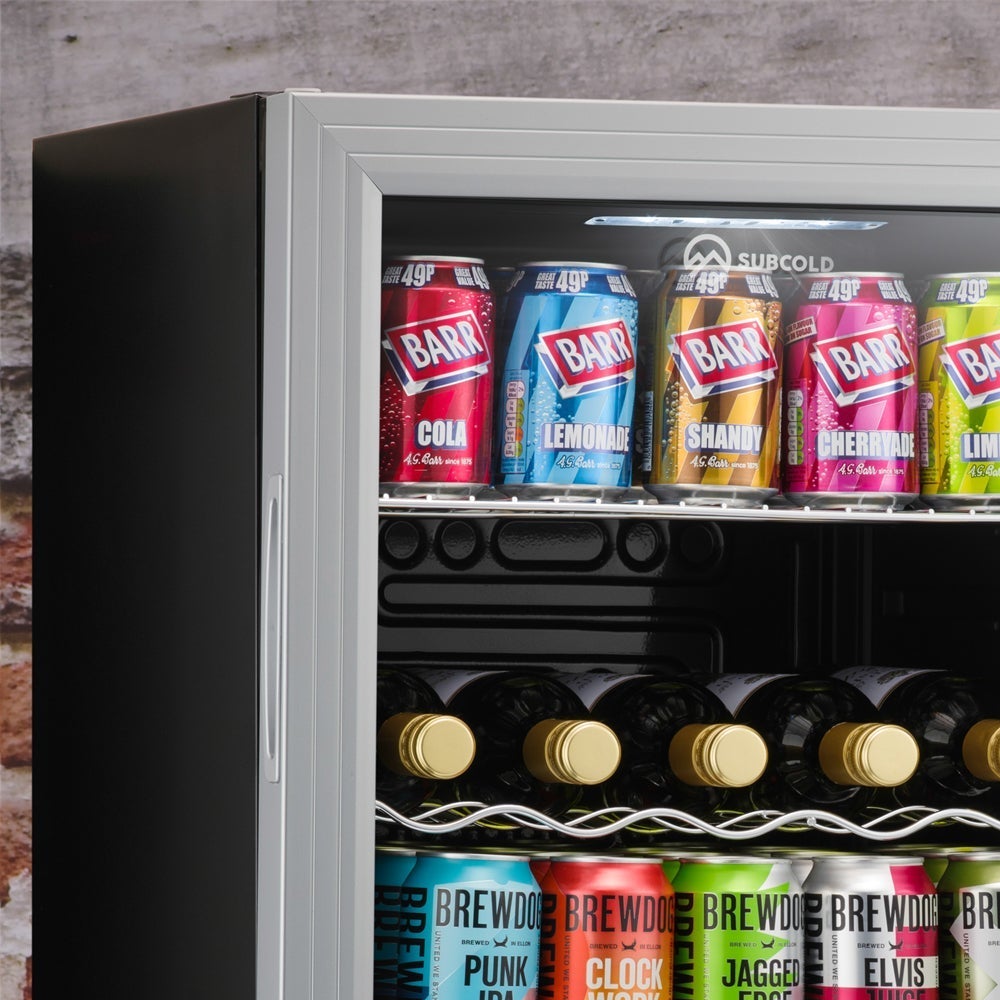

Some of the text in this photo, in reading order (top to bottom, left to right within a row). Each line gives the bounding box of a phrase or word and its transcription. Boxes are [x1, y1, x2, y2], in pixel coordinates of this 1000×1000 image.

[537, 273, 557, 281] GREAT
[738, 253, 834, 273] SUBCOLD
[535, 281, 554, 290] TASTE
[400, 321, 483, 369] BARR
[556, 326, 633, 374] BARR
[686, 326, 770, 373] BARR
[833, 333, 911, 381] BARR
[418, 420, 467, 446] COLA
[544, 423, 630, 451] LEMONADE
[688, 423, 763, 451] SHANDY
[818, 430, 915, 458] CHERRYADE
[433, 930, 441, 962] UNITED
[563, 936, 571, 966] UNITED
[962, 932, 970, 964] UNITED
[432, 965, 440, 978] WE
[464, 955, 528, 987] PUNK
[585, 957, 663, 990] CLOCK
[722, 958, 800, 988] JAGGED
[864, 958, 924, 987] ELVIS
